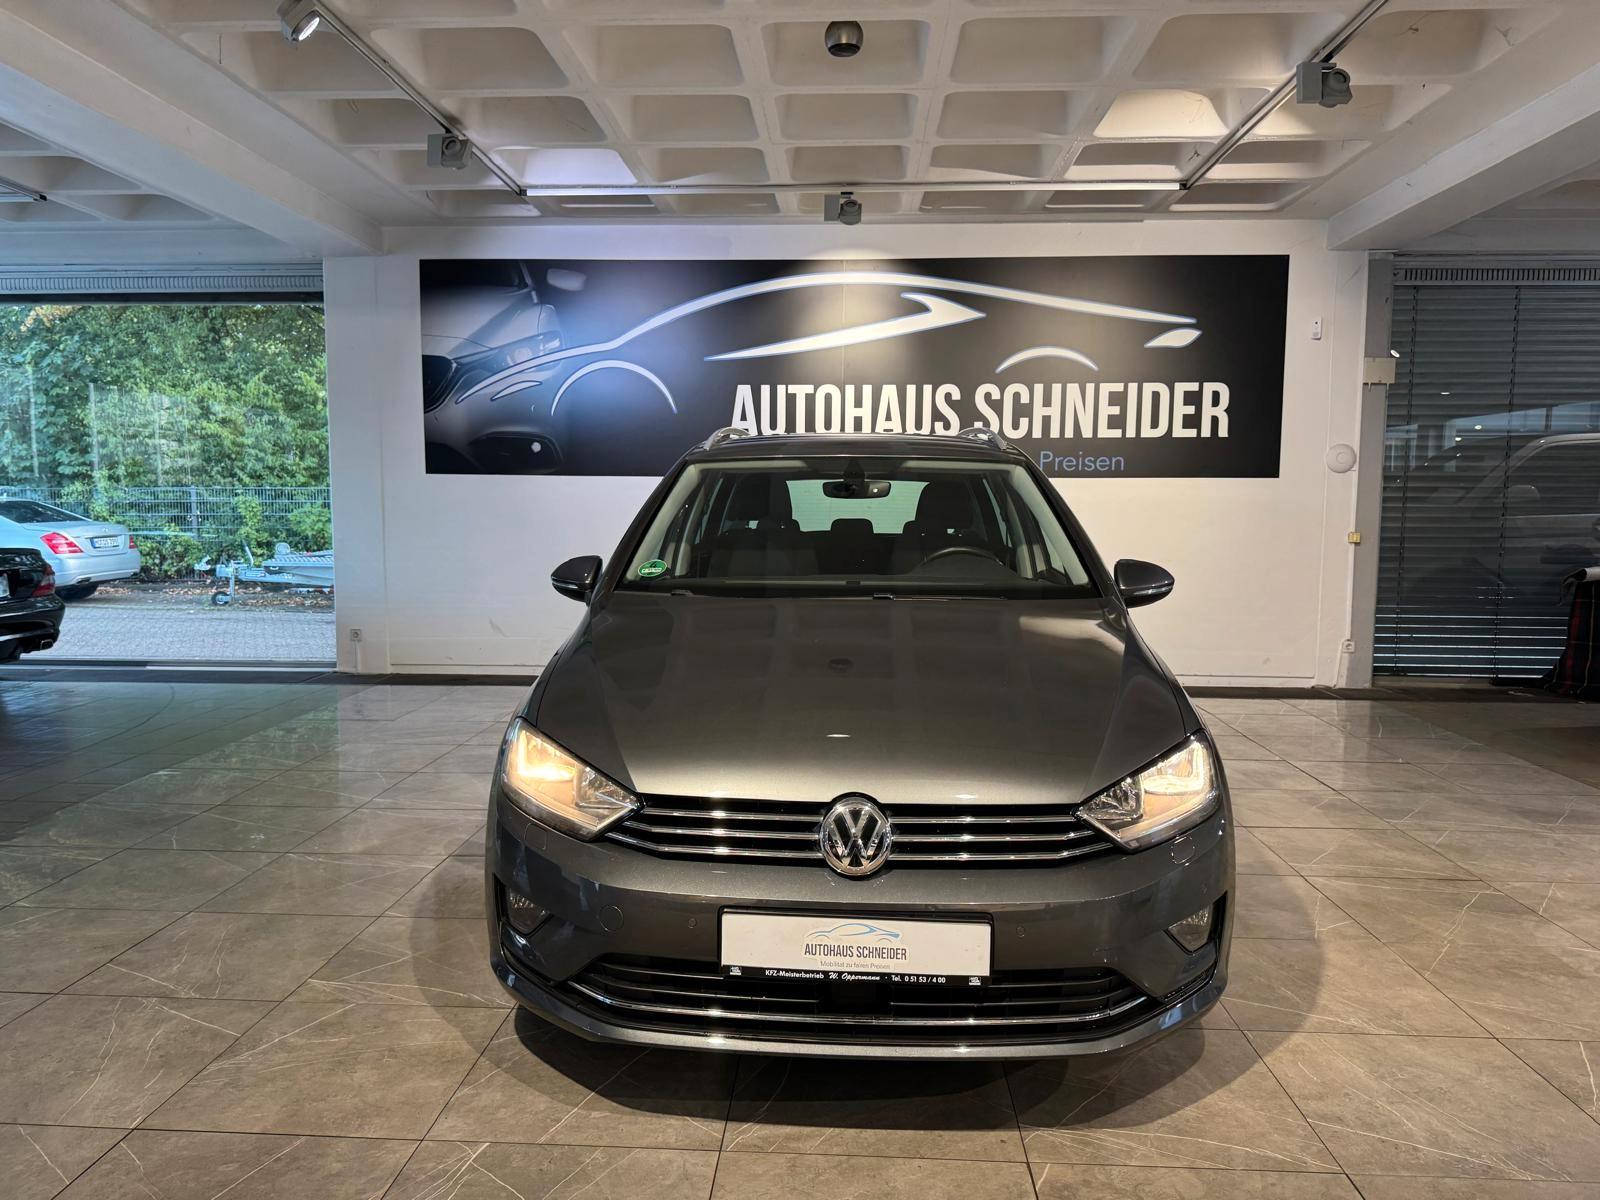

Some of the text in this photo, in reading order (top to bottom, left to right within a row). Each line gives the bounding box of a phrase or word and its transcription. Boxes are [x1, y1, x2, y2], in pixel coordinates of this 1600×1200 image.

[731, 381, 1231, 439] AUTOHAUS SCHNEIDER
[1040, 450, 1125, 472] Preisen
[804, 943, 907, 961] AUTOHAUS SCHNEIDER
[765, 969, 824, 979] KFZ-Meisterbetrieb
